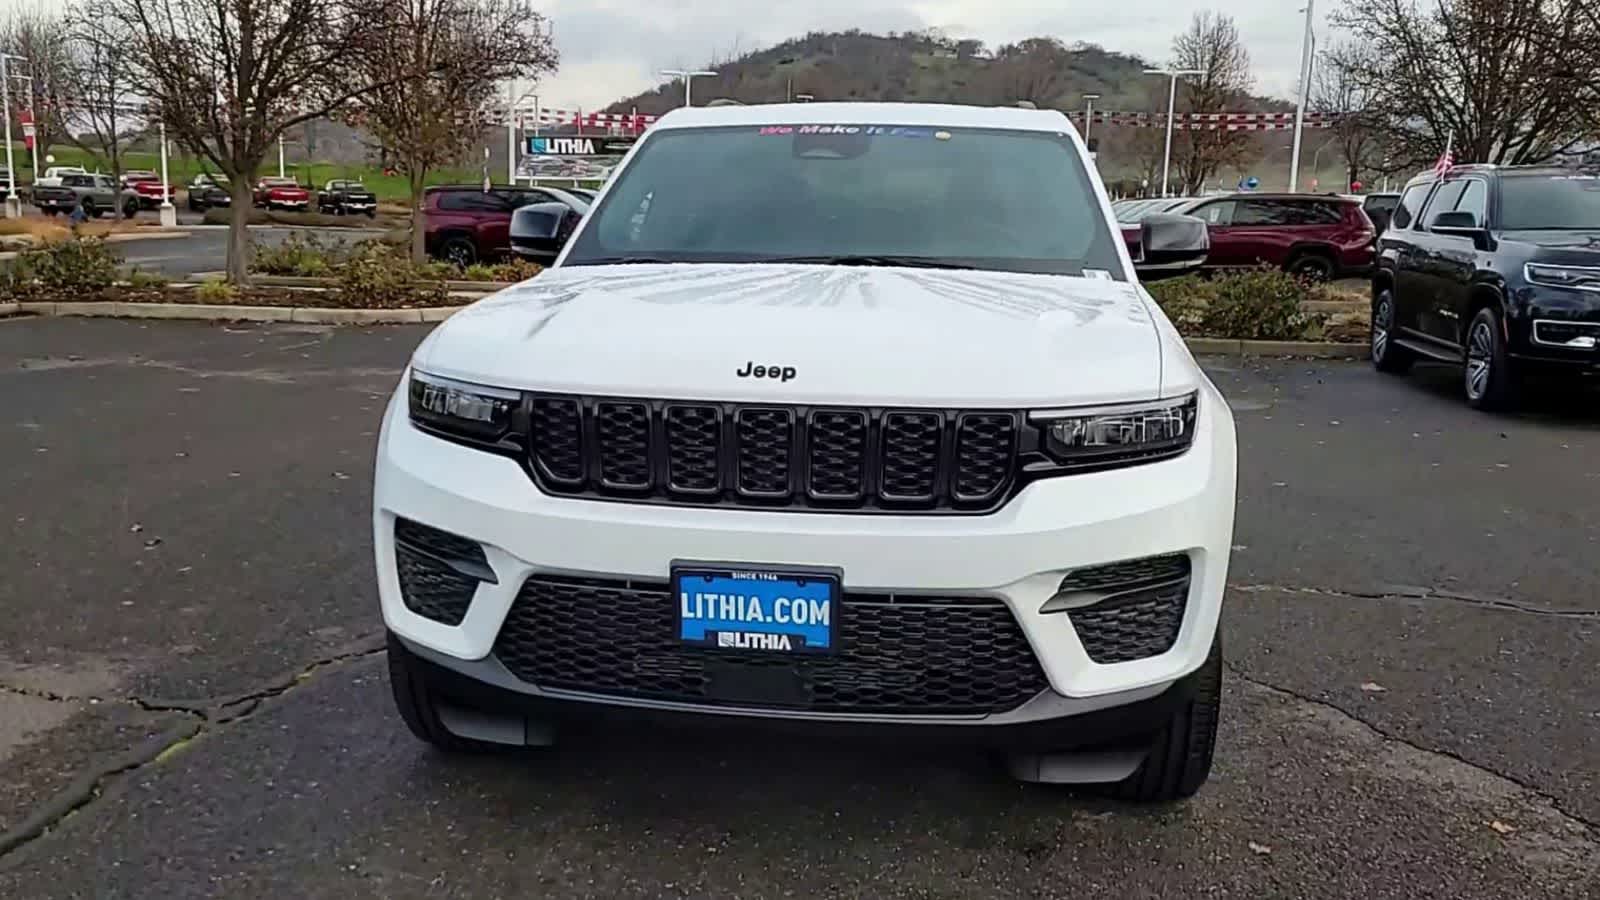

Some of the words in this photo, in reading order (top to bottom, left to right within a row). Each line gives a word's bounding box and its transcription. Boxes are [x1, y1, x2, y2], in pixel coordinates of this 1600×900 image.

[545, 138, 595, 154] LITHIA
[736, 361, 796, 382] Jeep
[732, 572, 757, 580] SINCE
[681, 592, 830, 626] LITHIA.COM
[735, 632, 792, 650] LITHIA
